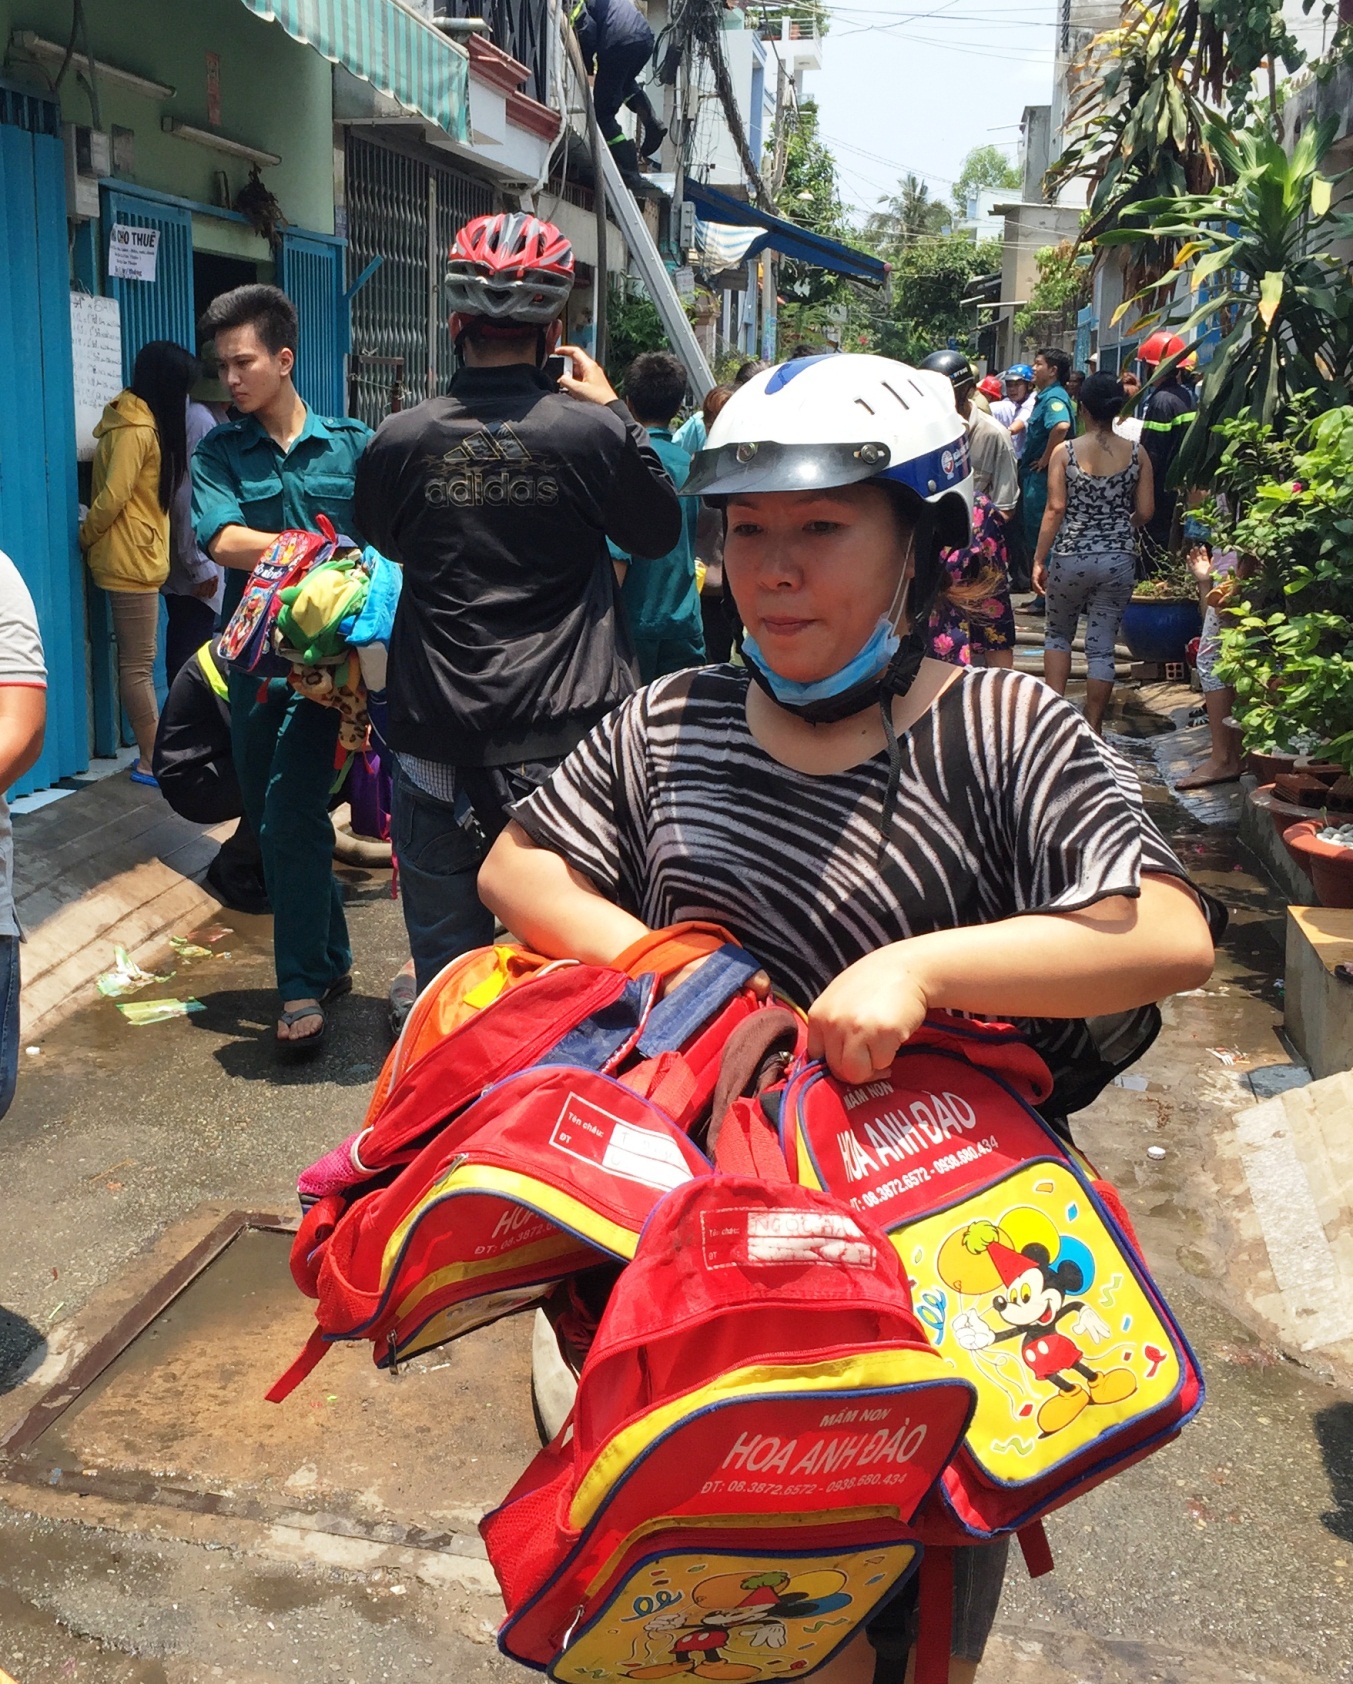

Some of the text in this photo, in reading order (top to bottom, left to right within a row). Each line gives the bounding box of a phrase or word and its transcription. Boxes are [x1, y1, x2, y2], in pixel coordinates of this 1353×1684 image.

[131, 231, 156, 248] THUÊ
[424, 472, 560, 510] adidas
[864, 1109, 929, 1167] ANH
[861, 1166, 932, 1208] 08.3872.6572
[932, 1134, 1000, 1175] 0938.680.434
[859, 1407, 893, 1422] NON
[721, 1416, 928, 1476] HOA ANH ĐÀO
[700, 1480, 725, 1494] ĐT:
[727, 1480, 818, 1496] 08.3872.6572
[825, 1472, 908, 1494] 0938.680.434
